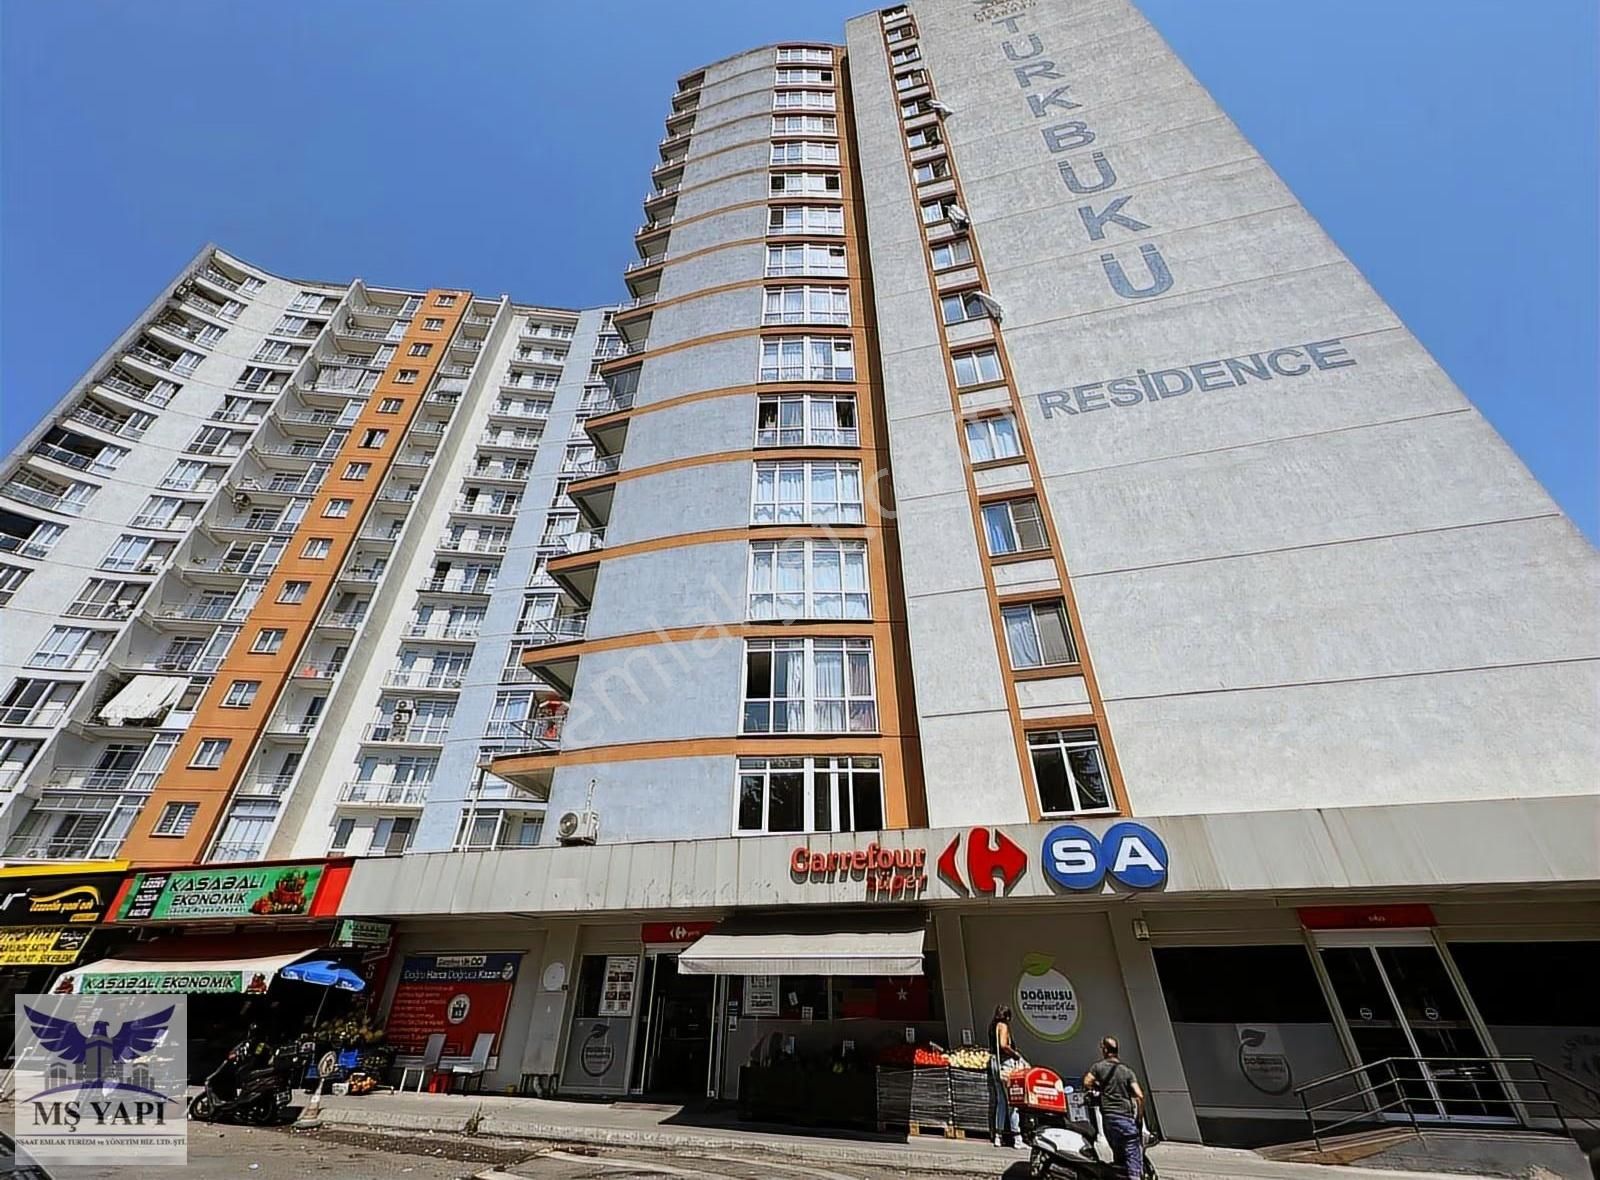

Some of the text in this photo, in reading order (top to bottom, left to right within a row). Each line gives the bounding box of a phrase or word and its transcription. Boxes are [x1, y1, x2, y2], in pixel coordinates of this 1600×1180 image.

[992, 13, 1174, 299] TÜRKBÜKÜ
[790, 842, 926, 873] Carrefour
[169, 874, 267, 892] KASABALI
[86, 976, 160, 989] KASABALI
[1020, 987, 1073, 1001] DOĞRUSU
